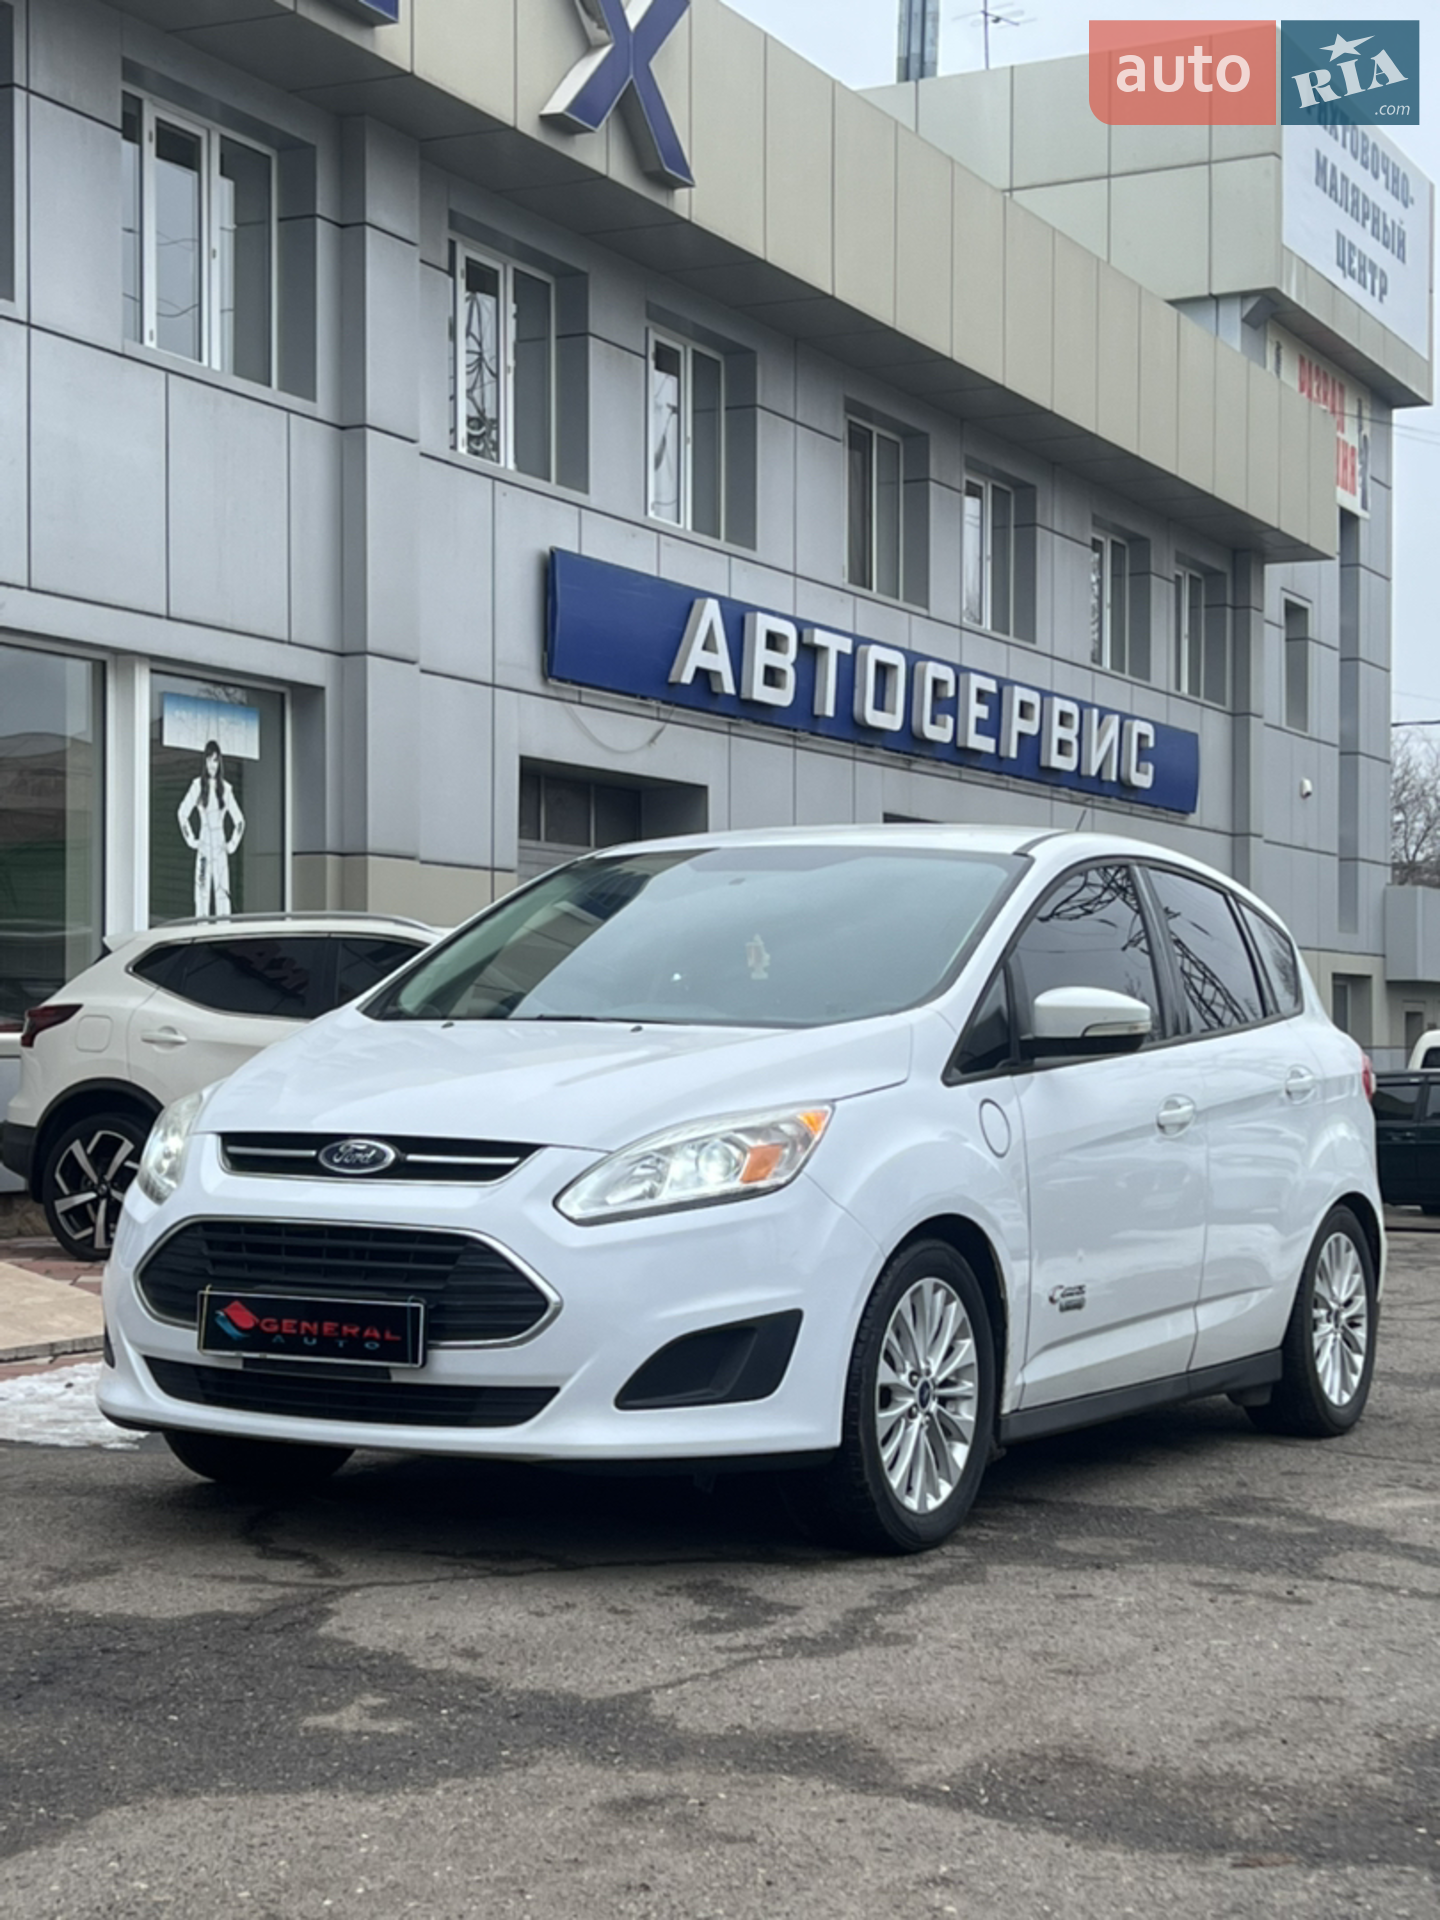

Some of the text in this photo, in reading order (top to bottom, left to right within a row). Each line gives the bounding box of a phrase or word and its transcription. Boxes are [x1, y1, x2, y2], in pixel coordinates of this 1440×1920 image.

[1315, 147, 1407, 265] МАЛЯРНЫЙ
[1336, 229, 1388, 304] ЦЕНТР
[668, 597, 1155, 789] АВТОСЕРВИС
[332, 1143, 377, 1164] Ford
[260, 1317, 402, 1342] GENERAL
[272, 1334, 380, 1351] AUTO
